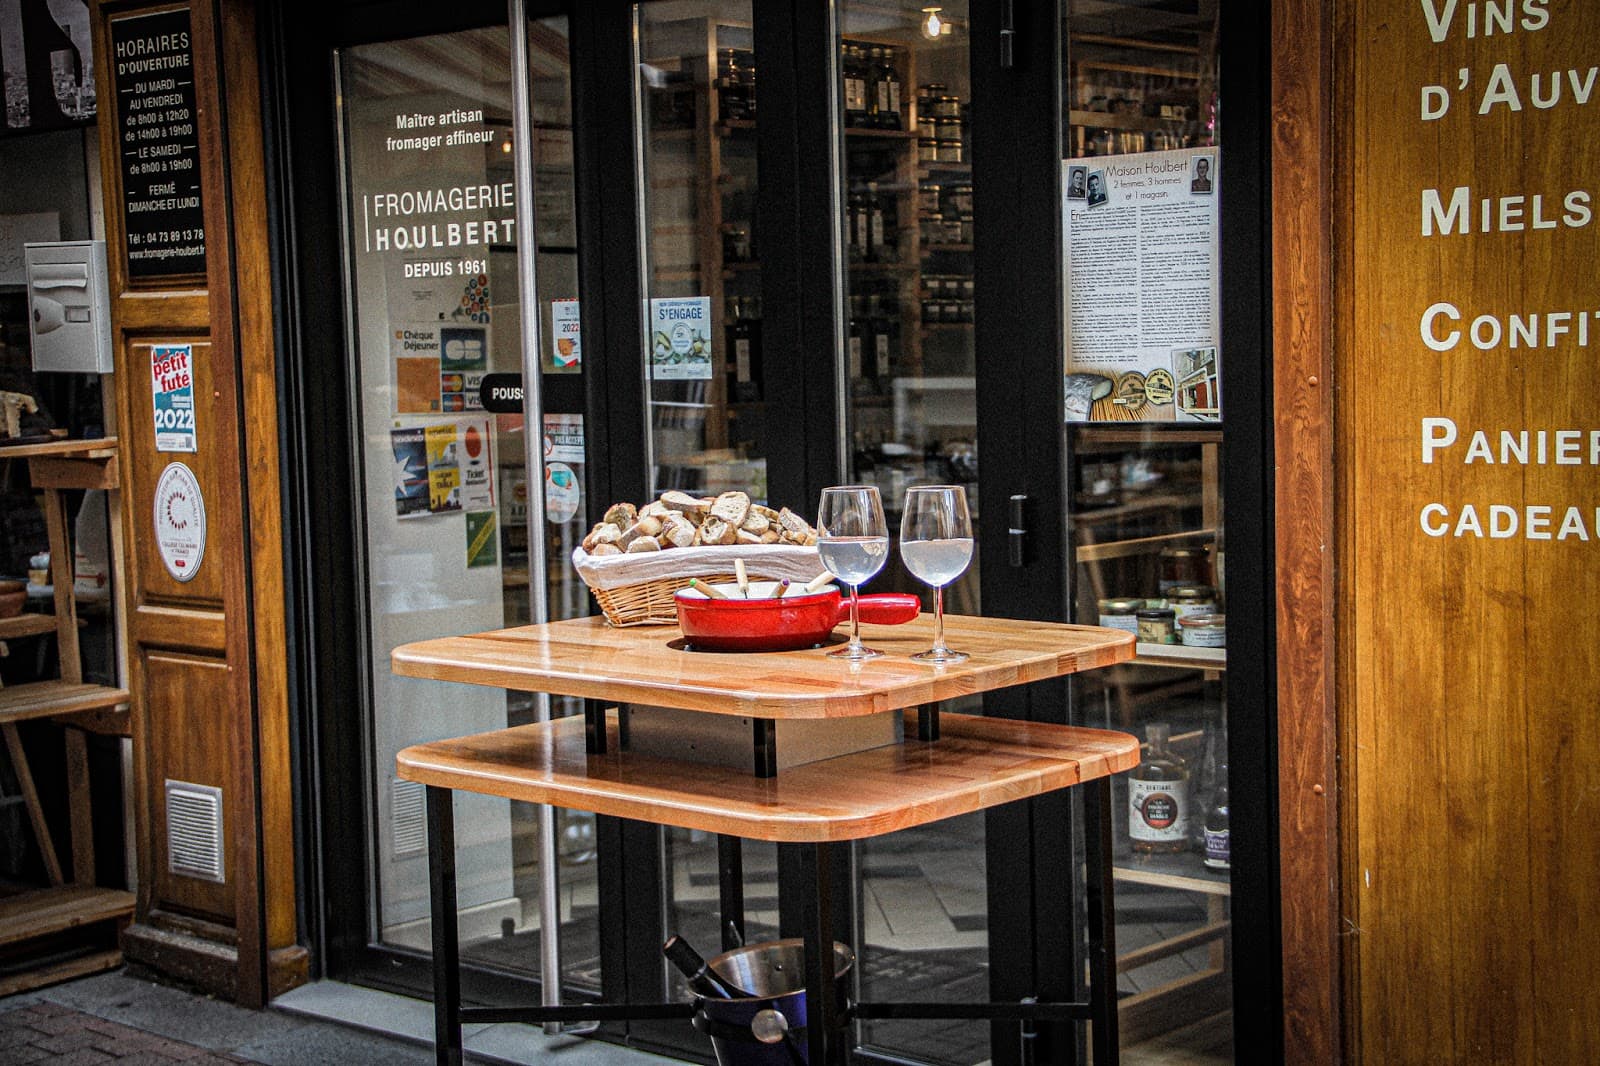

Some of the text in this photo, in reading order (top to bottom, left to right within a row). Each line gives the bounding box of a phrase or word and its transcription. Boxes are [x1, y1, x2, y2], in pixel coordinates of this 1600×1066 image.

[117, 32, 189, 57] HORAIRES
[119, 54, 190, 75] D'OUVERTURE
[135, 79, 175, 93] DU MARDI
[129, 93, 183, 110] AU VENDREDI
[126, 108, 189, 126] de 8h00 à 12h20
[396, 109, 483, 129] Maître artisan
[125, 124, 192, 141] de 14h00 à 19h00
[386, 129, 494, 151] fromager affineur
[138, 144, 181, 159] LE SAMEDI
[130, 158, 193, 175] de 8h00 à 19h00
[1105, 159, 1188, 177] Maison Houlbert
[1154, 176, 1181, 186] hommes
[374, 183, 514, 217] FROMAGERIE
[1141, 190, 1169, 201] magasin
[128, 197, 199, 213] DIMANCHE ET LUNDI
[1421, 186, 1592, 237] MIELS
[147, 232, 156, 243] 04
[159, 231, 168, 242] 73
[182, 230, 192, 241] 13
[194, 229, 204, 240] 78
[375, 219, 515, 251] HOULBERT
[404, 259, 487, 278] DEPUIS 1961
[659, 307, 702, 320] S'ENGAGE
[404, 330, 434, 341] Chèque
[562, 323, 579, 333] 2022
[1420, 302, 1600, 351] CONFI
[404, 341, 439, 352] Déjeuner
[153, 352, 188, 381] petit
[161, 370, 190, 393] futé
[467, 376, 481, 386] VIS
[155, 408, 193, 429] 2022
[1420, 503, 1600, 541] CADEA
